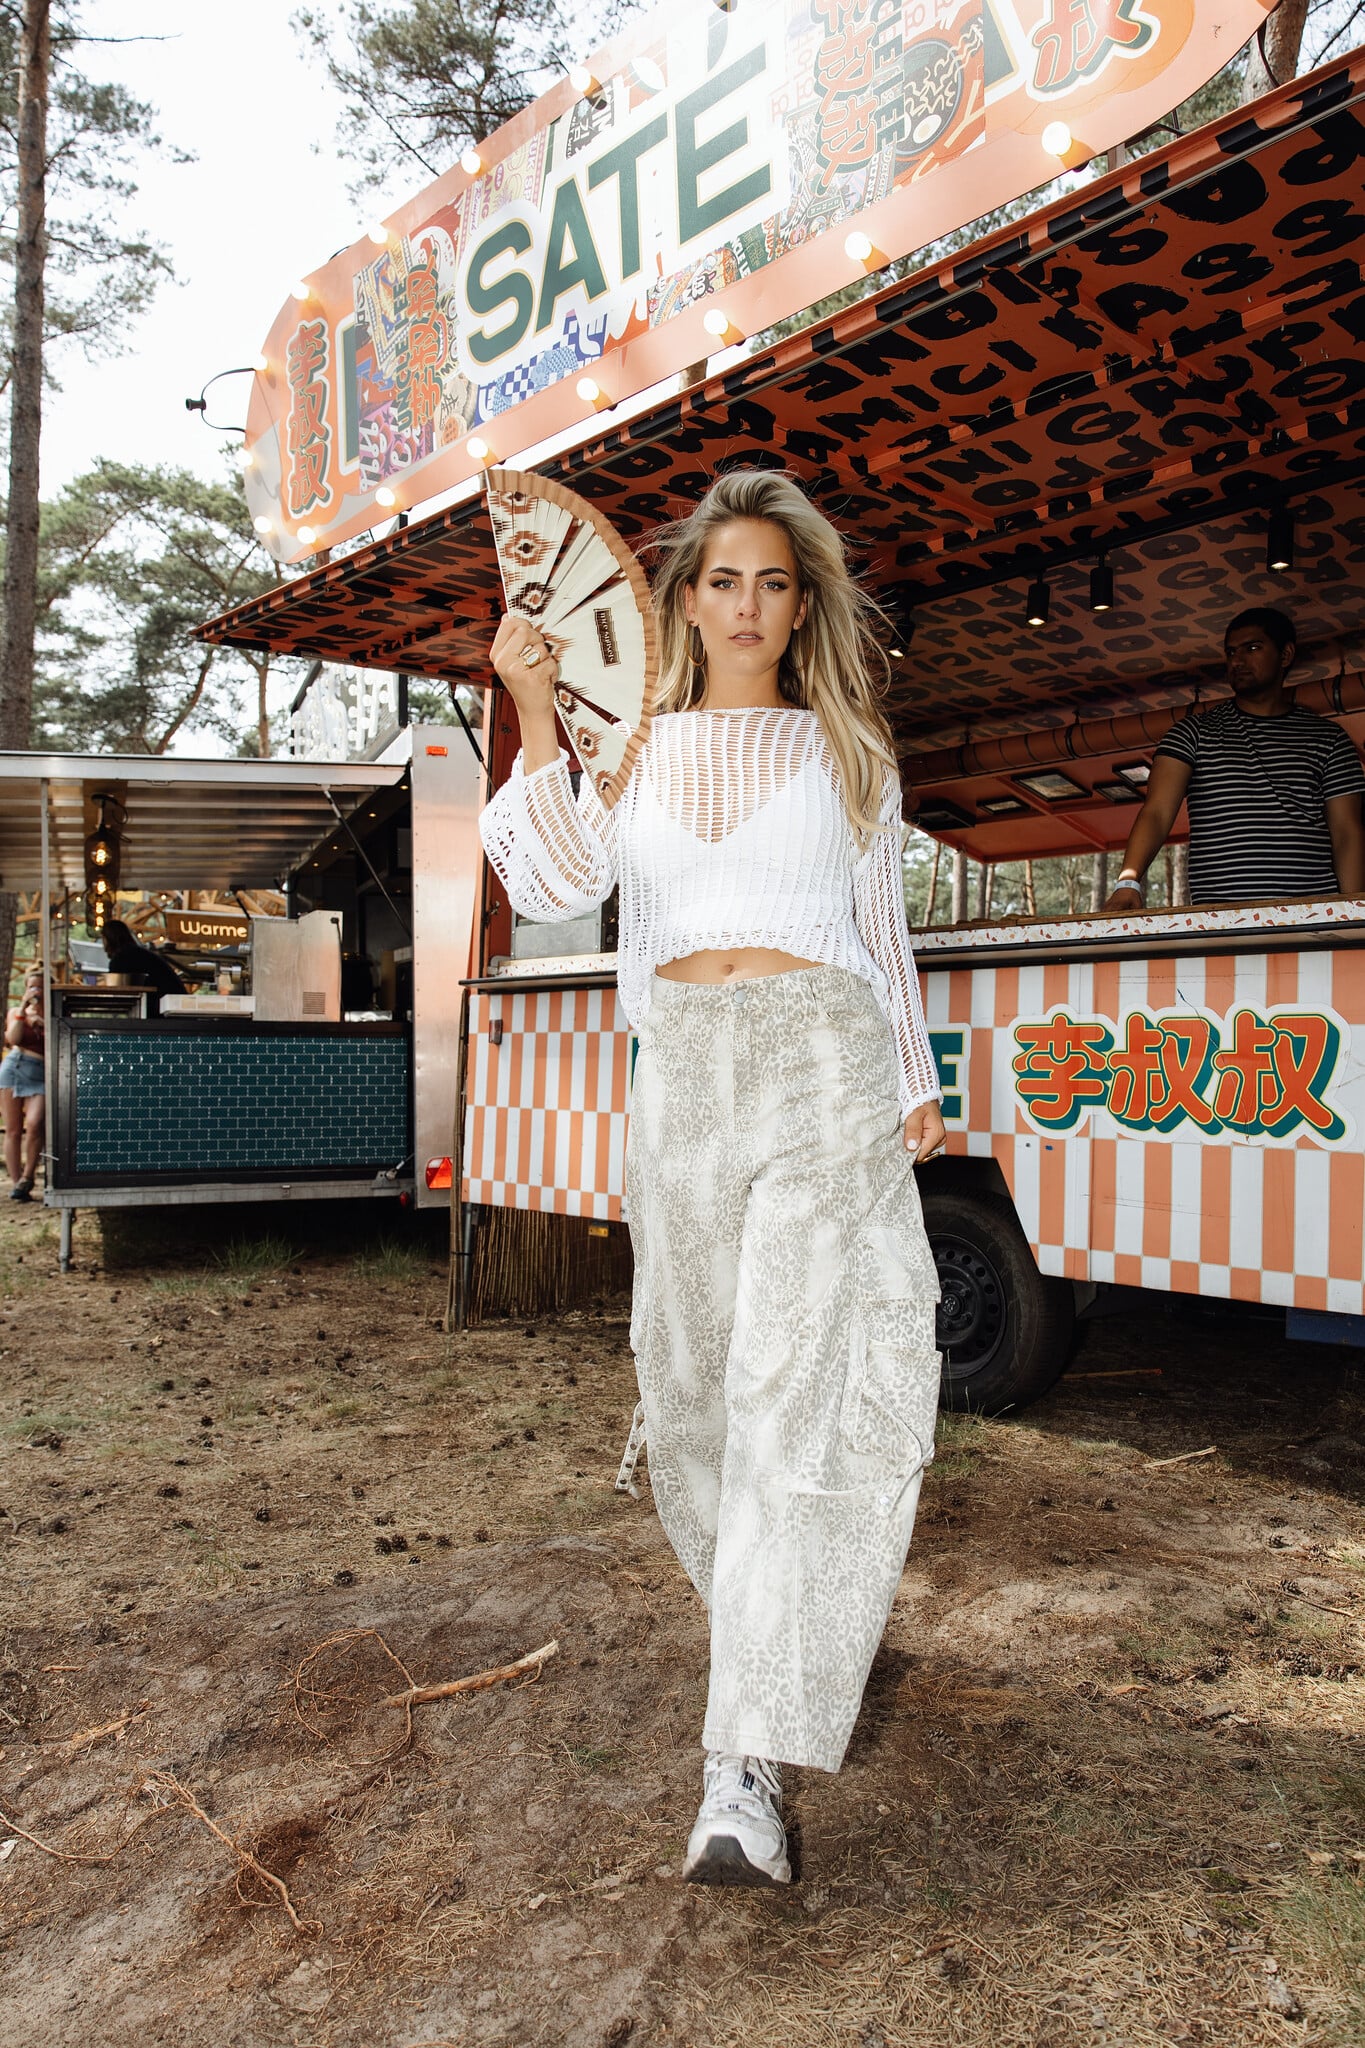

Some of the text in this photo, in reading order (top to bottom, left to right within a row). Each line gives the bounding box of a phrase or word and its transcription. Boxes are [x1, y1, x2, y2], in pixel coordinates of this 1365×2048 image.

[392, 277, 412, 332] LEE
[406, 248, 444, 430] 李叔叔
[288, 321, 330, 515] 李叔叔
[394, 337, 413, 432] UNCLE
[776, 339, 1038, 467] AMICI
[180, 920, 248, 938] Warme
[1013, 1009, 1346, 1141] 李叔叔
